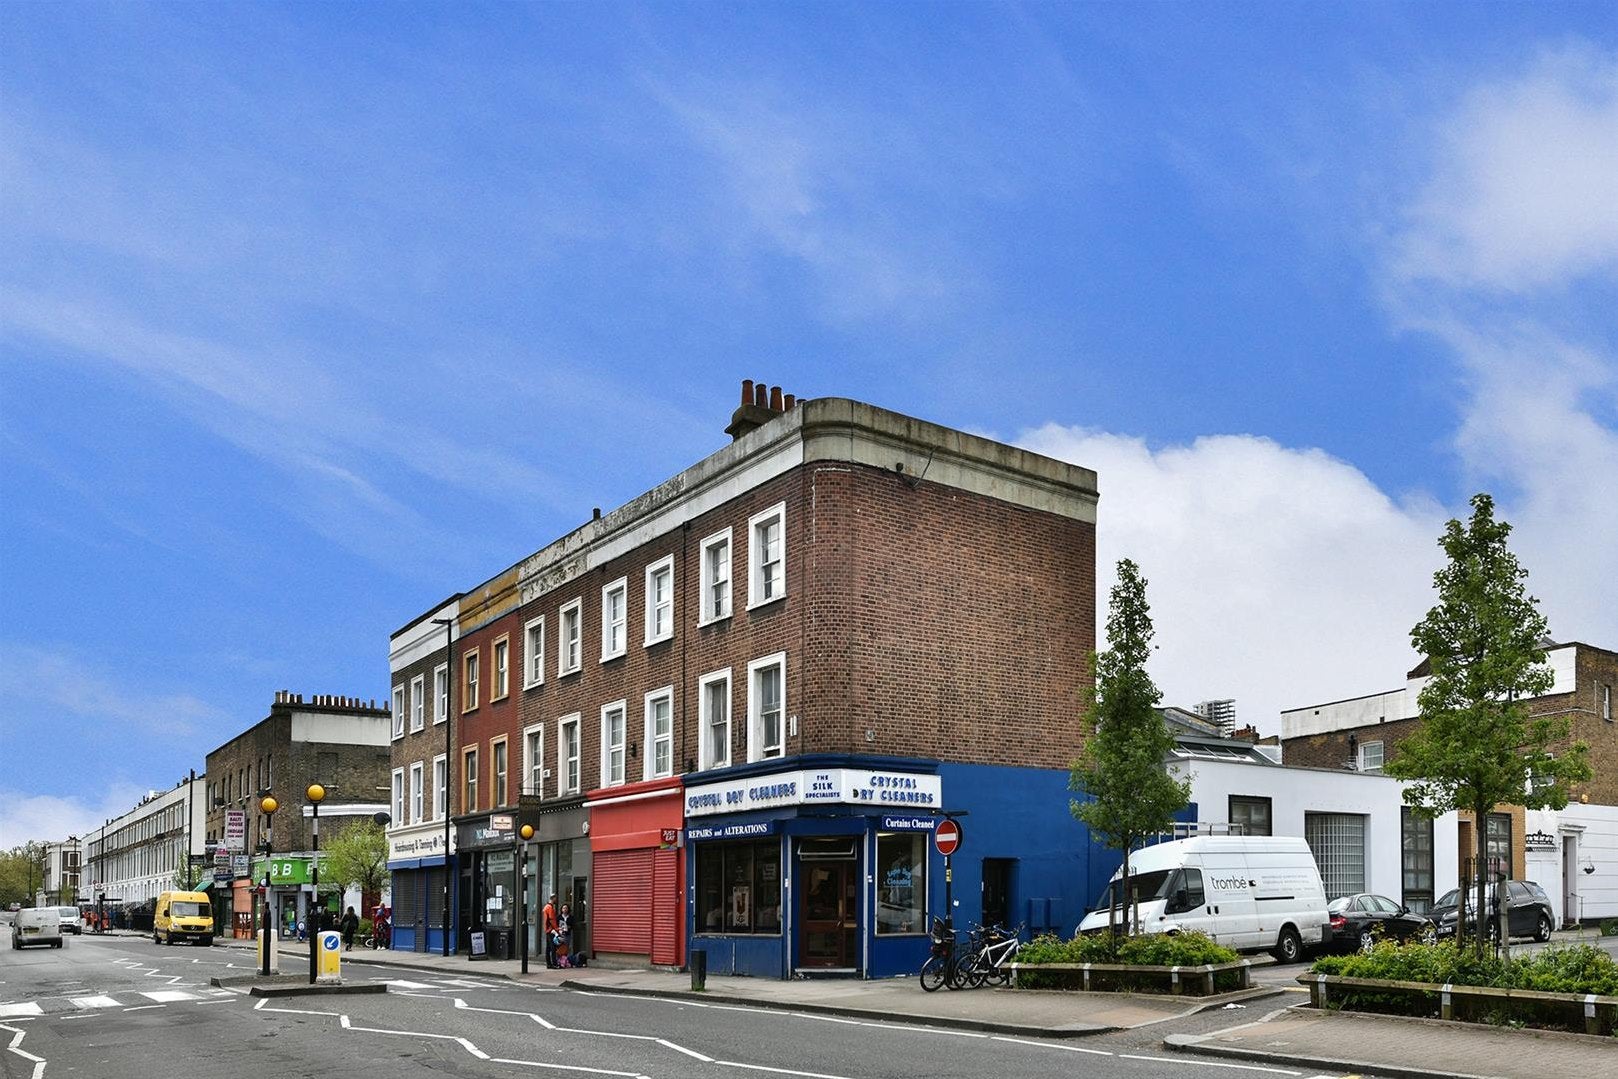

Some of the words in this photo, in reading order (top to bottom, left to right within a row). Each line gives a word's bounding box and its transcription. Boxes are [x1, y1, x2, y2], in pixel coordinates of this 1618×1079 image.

[812, 782, 833, 790] SILK
[870, 775, 917, 788] CRYSTAL
[688, 793, 722, 809] CRYSTAL
[726, 789, 744, 804] DRY
[749, 782, 796, 801] CLEANERS
[805, 791, 840, 799] SPECIALISTS
[852, 788, 873, 800] DRY
[880, 790, 934, 803] CLEANERS
[885, 818, 911, 828] Curtains
[911, 819, 935, 829] Cleaned
[688, 828, 713, 839] REPAIRS
[724, 824, 768, 836] ALTERATIONS
